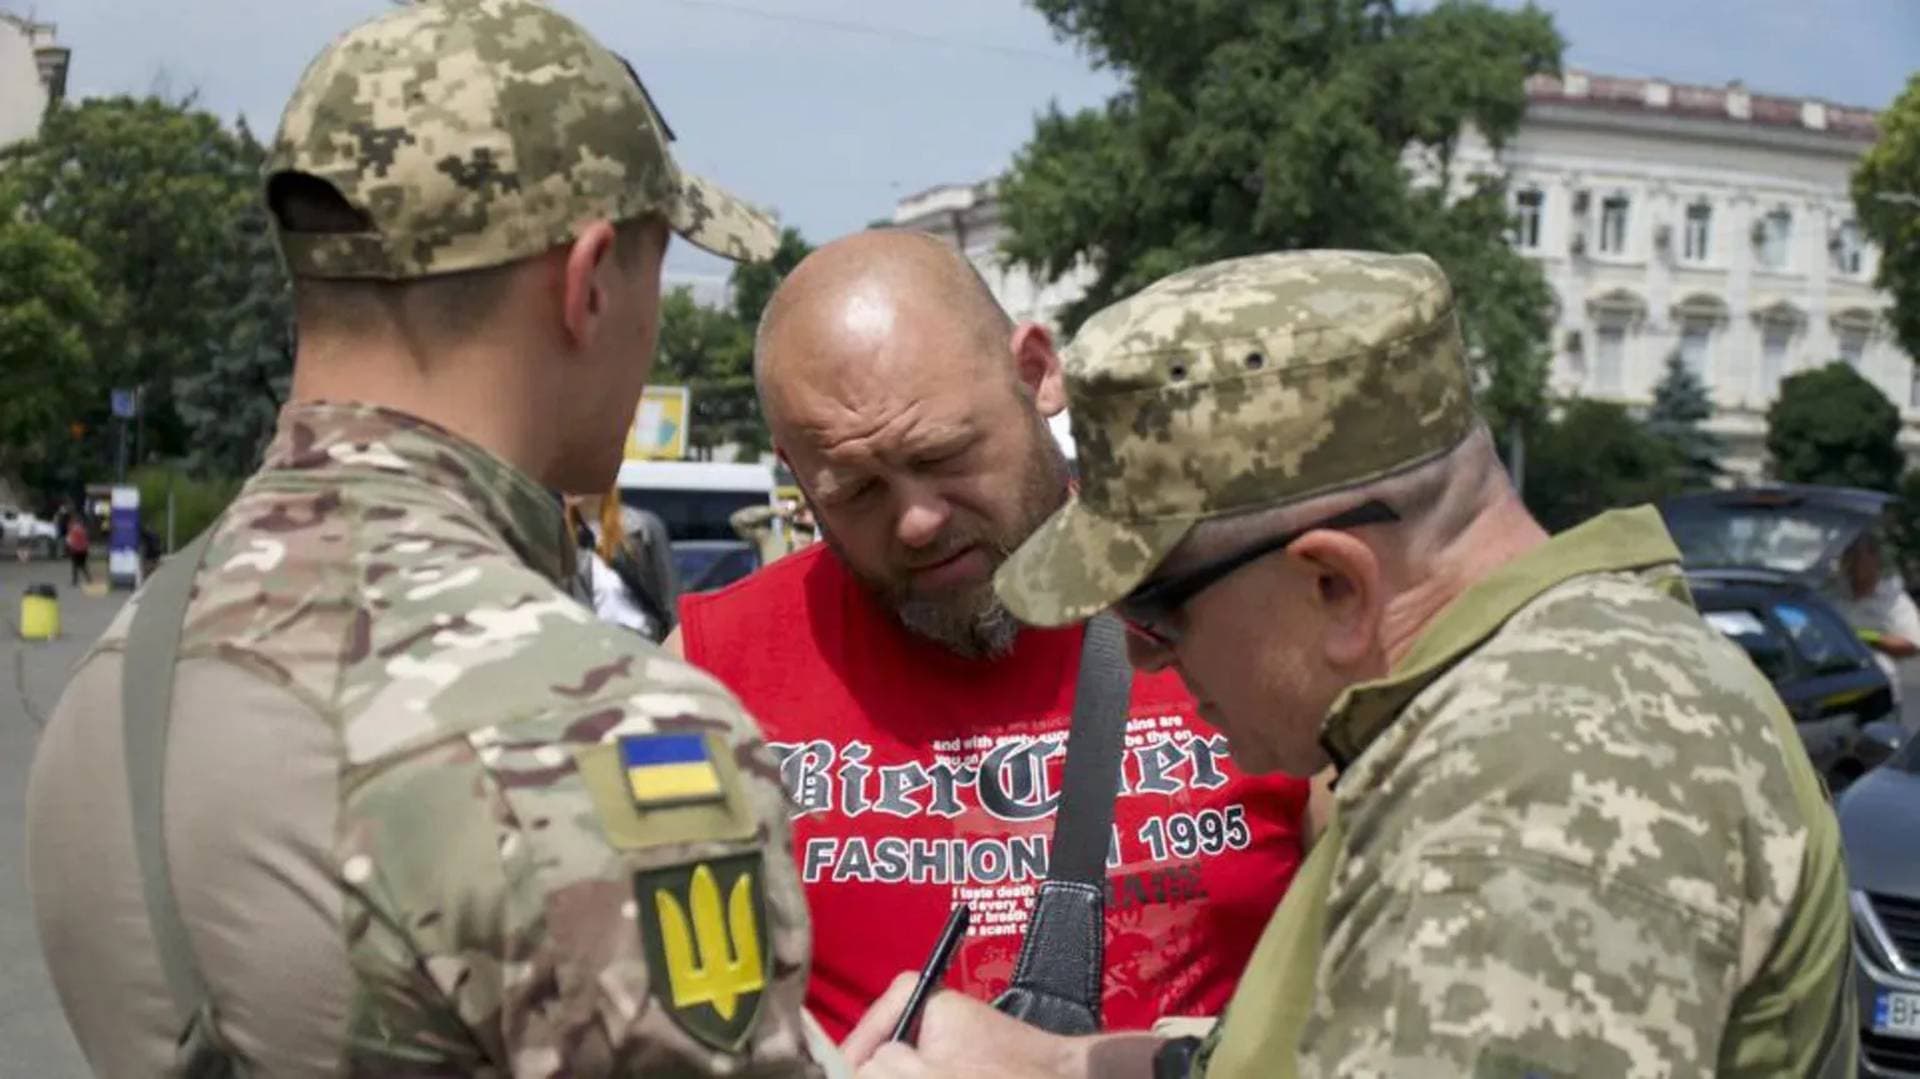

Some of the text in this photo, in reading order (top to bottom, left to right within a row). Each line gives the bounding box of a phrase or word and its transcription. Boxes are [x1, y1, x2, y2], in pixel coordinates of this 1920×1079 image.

[802, 835, 1050, 884] FASHION
[1138, 804, 1251, 862] 1995
[997, 884, 1034, 899] death
